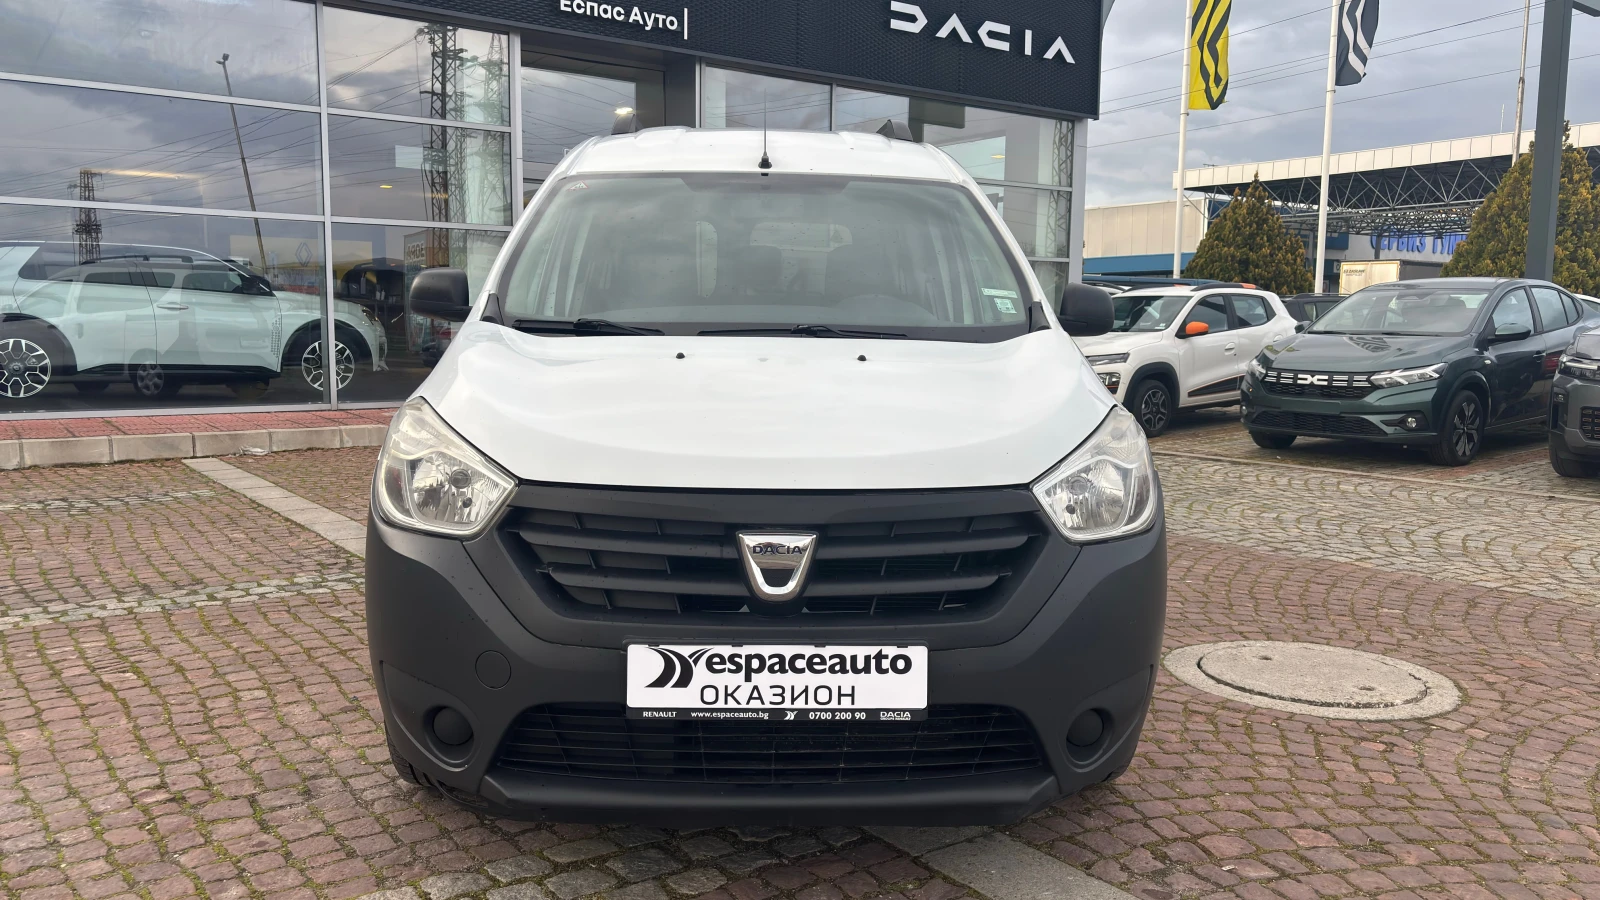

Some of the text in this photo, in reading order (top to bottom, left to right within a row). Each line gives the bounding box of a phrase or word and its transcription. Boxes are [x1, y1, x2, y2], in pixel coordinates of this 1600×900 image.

[560, 0, 678, 31] Еспас Ауто
[890, 0, 1076, 64] DACIA
[752, 545, 803, 555] DACIA
[705, 648, 912, 683] espaceauto
[700, 684, 856, 706] ОКАЗИОН
[690, 710, 769, 720] www.espaceauto.bg
[809, 711, 832, 720] 0700
[834, 711, 852, 720] 200
[853, 711, 866, 720] 90
